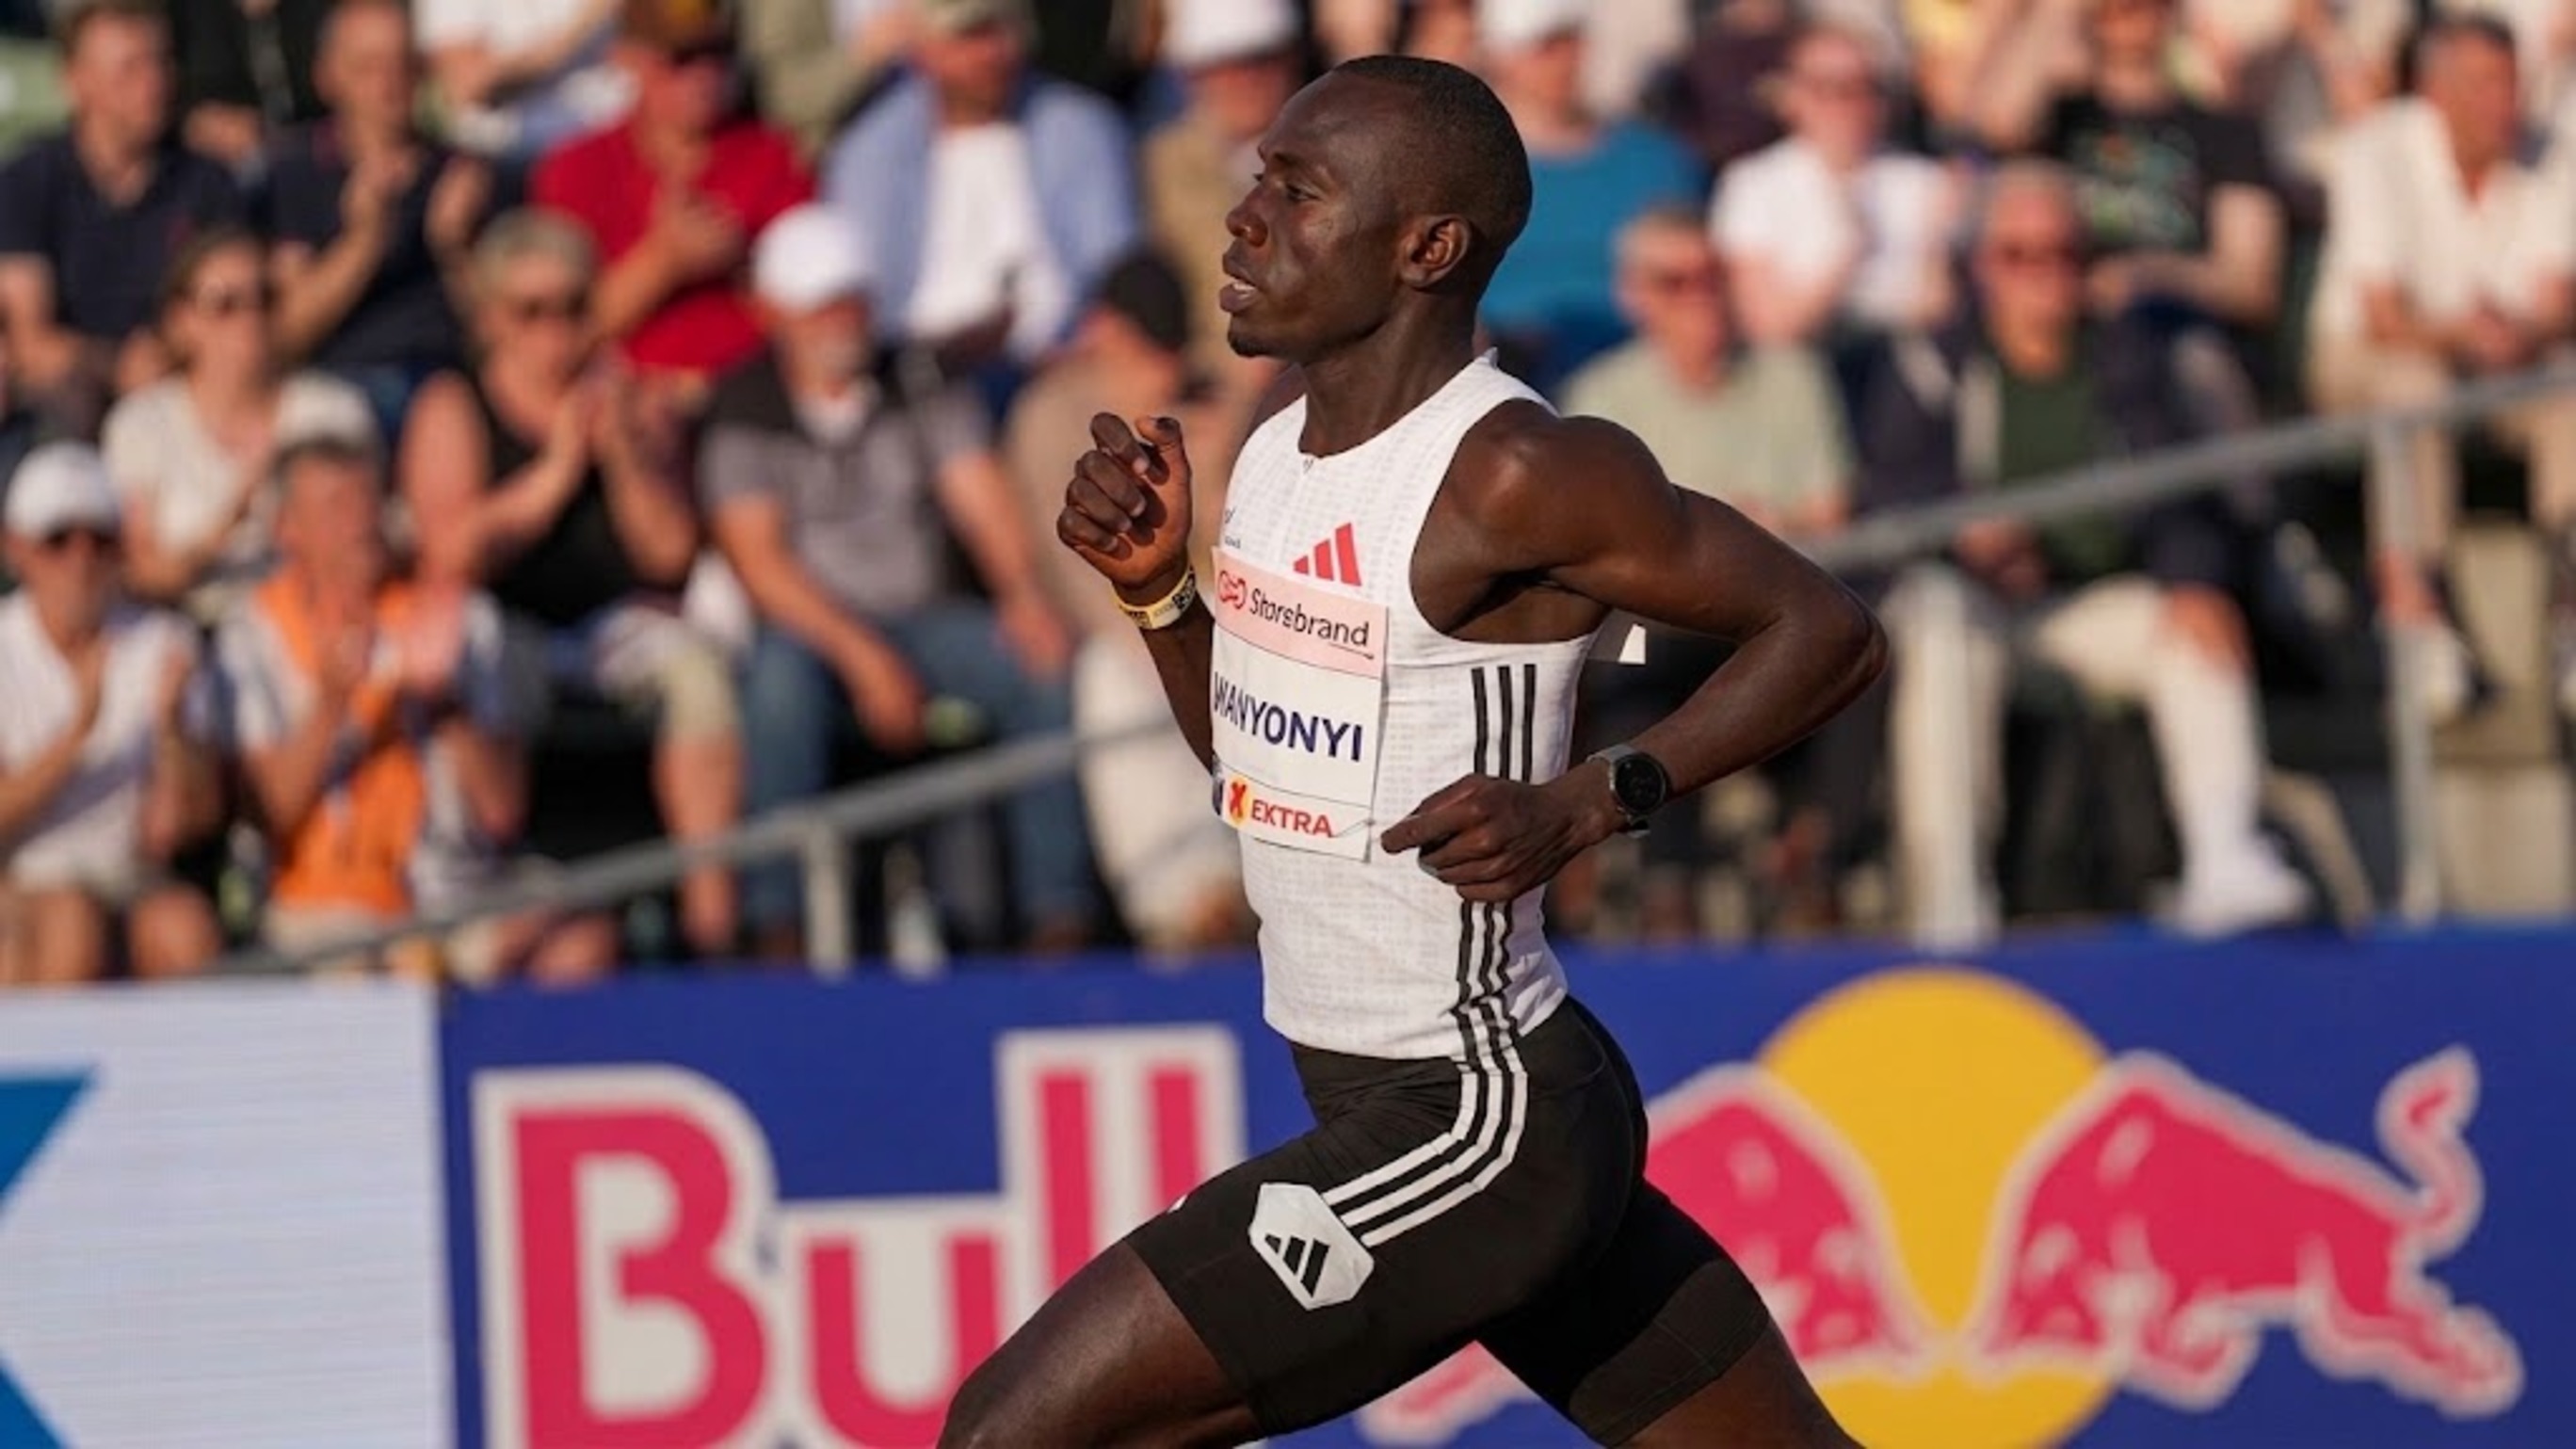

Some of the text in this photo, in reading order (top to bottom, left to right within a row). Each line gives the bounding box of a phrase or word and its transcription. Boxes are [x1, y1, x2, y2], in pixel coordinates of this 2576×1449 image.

[1249, 588, 1370, 647] Storebrand
[1214, 670, 1363, 762] WANYONYI
[1250, 798, 1334, 839] EXTRA
